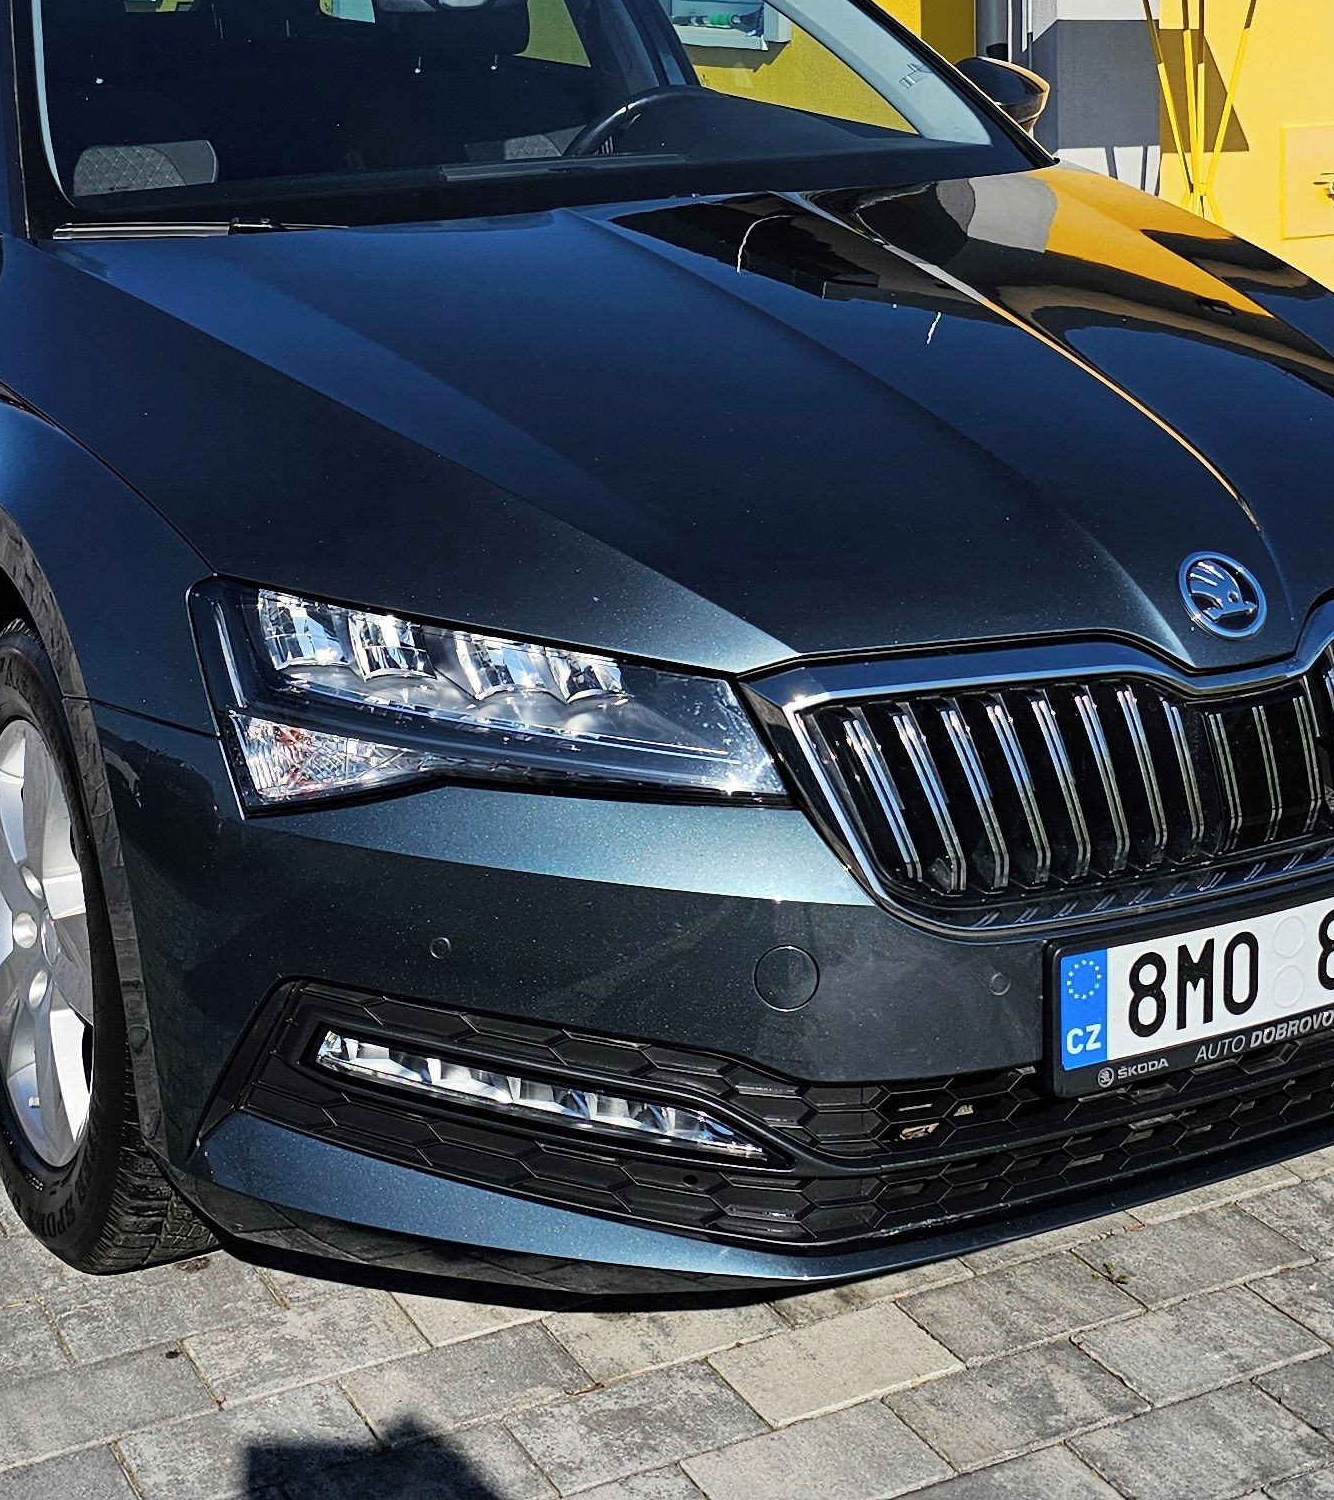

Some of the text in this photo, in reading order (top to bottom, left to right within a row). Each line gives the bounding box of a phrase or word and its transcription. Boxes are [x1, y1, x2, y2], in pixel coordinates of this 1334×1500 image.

[1128, 930, 1259, 1038] 8M0
[1066, 1023, 1102, 1055] CZ
[1194, 1034, 1246, 1063] AUTO
[1117, 1058, 1169, 1080] ŠKODA
